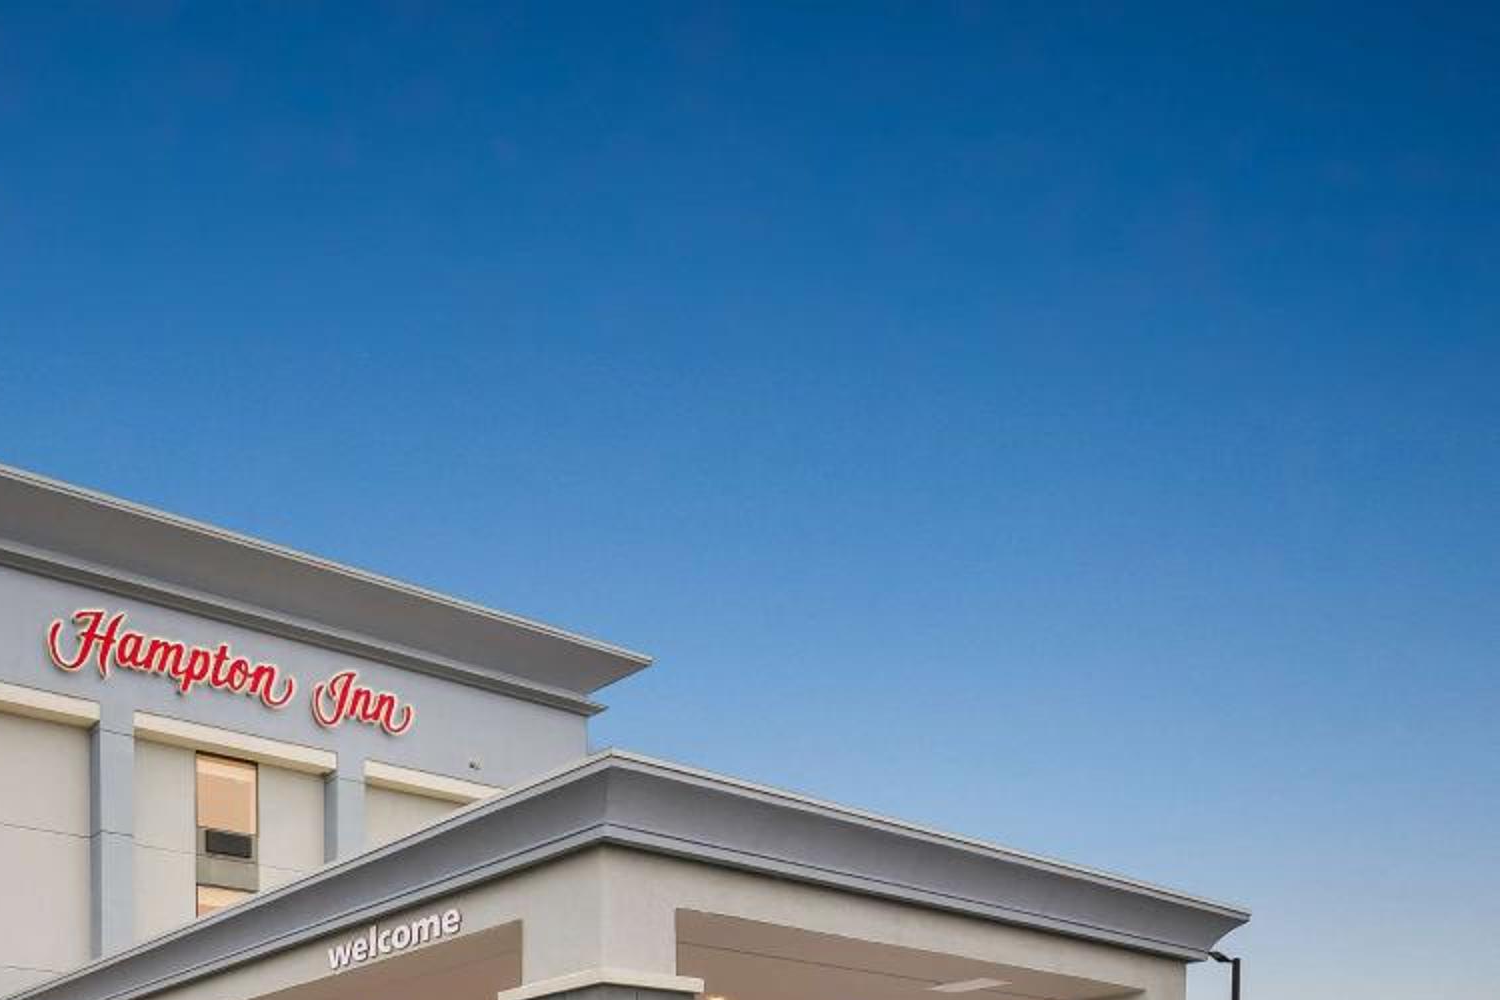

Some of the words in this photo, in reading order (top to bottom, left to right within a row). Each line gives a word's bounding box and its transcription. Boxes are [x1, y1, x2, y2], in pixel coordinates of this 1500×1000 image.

[47, 610, 295, 708] Hampton
[312, 671, 412, 733] Inn
[328, 909, 461, 969] welcome
